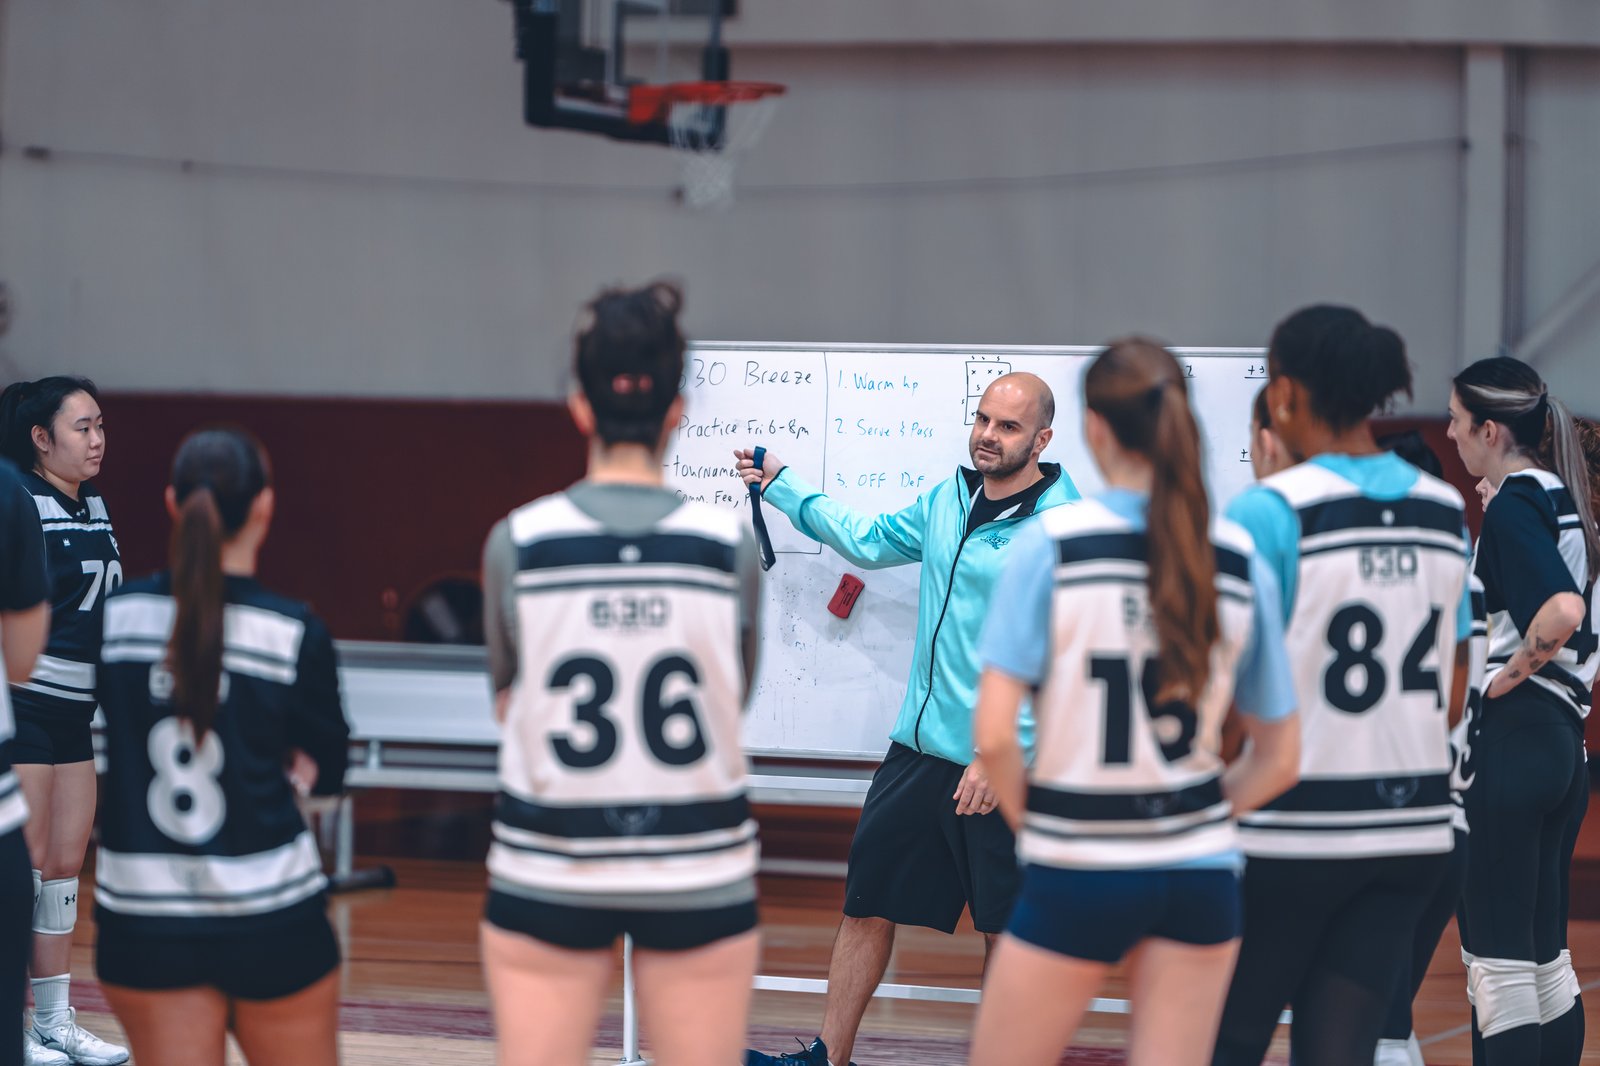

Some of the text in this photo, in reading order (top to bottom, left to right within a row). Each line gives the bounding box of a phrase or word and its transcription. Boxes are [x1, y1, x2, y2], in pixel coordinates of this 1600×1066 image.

[744, 360, 812, 387] Breeze
[853, 372, 894, 390] Warm
[678, 414, 737, 440] Practice
[857, 418, 890, 436] Serve
[78, 559, 123, 612] 70
[1324, 604, 1445, 713] 84
[548, 653, 708, 769] 36
[148, 716, 227, 844] 8
